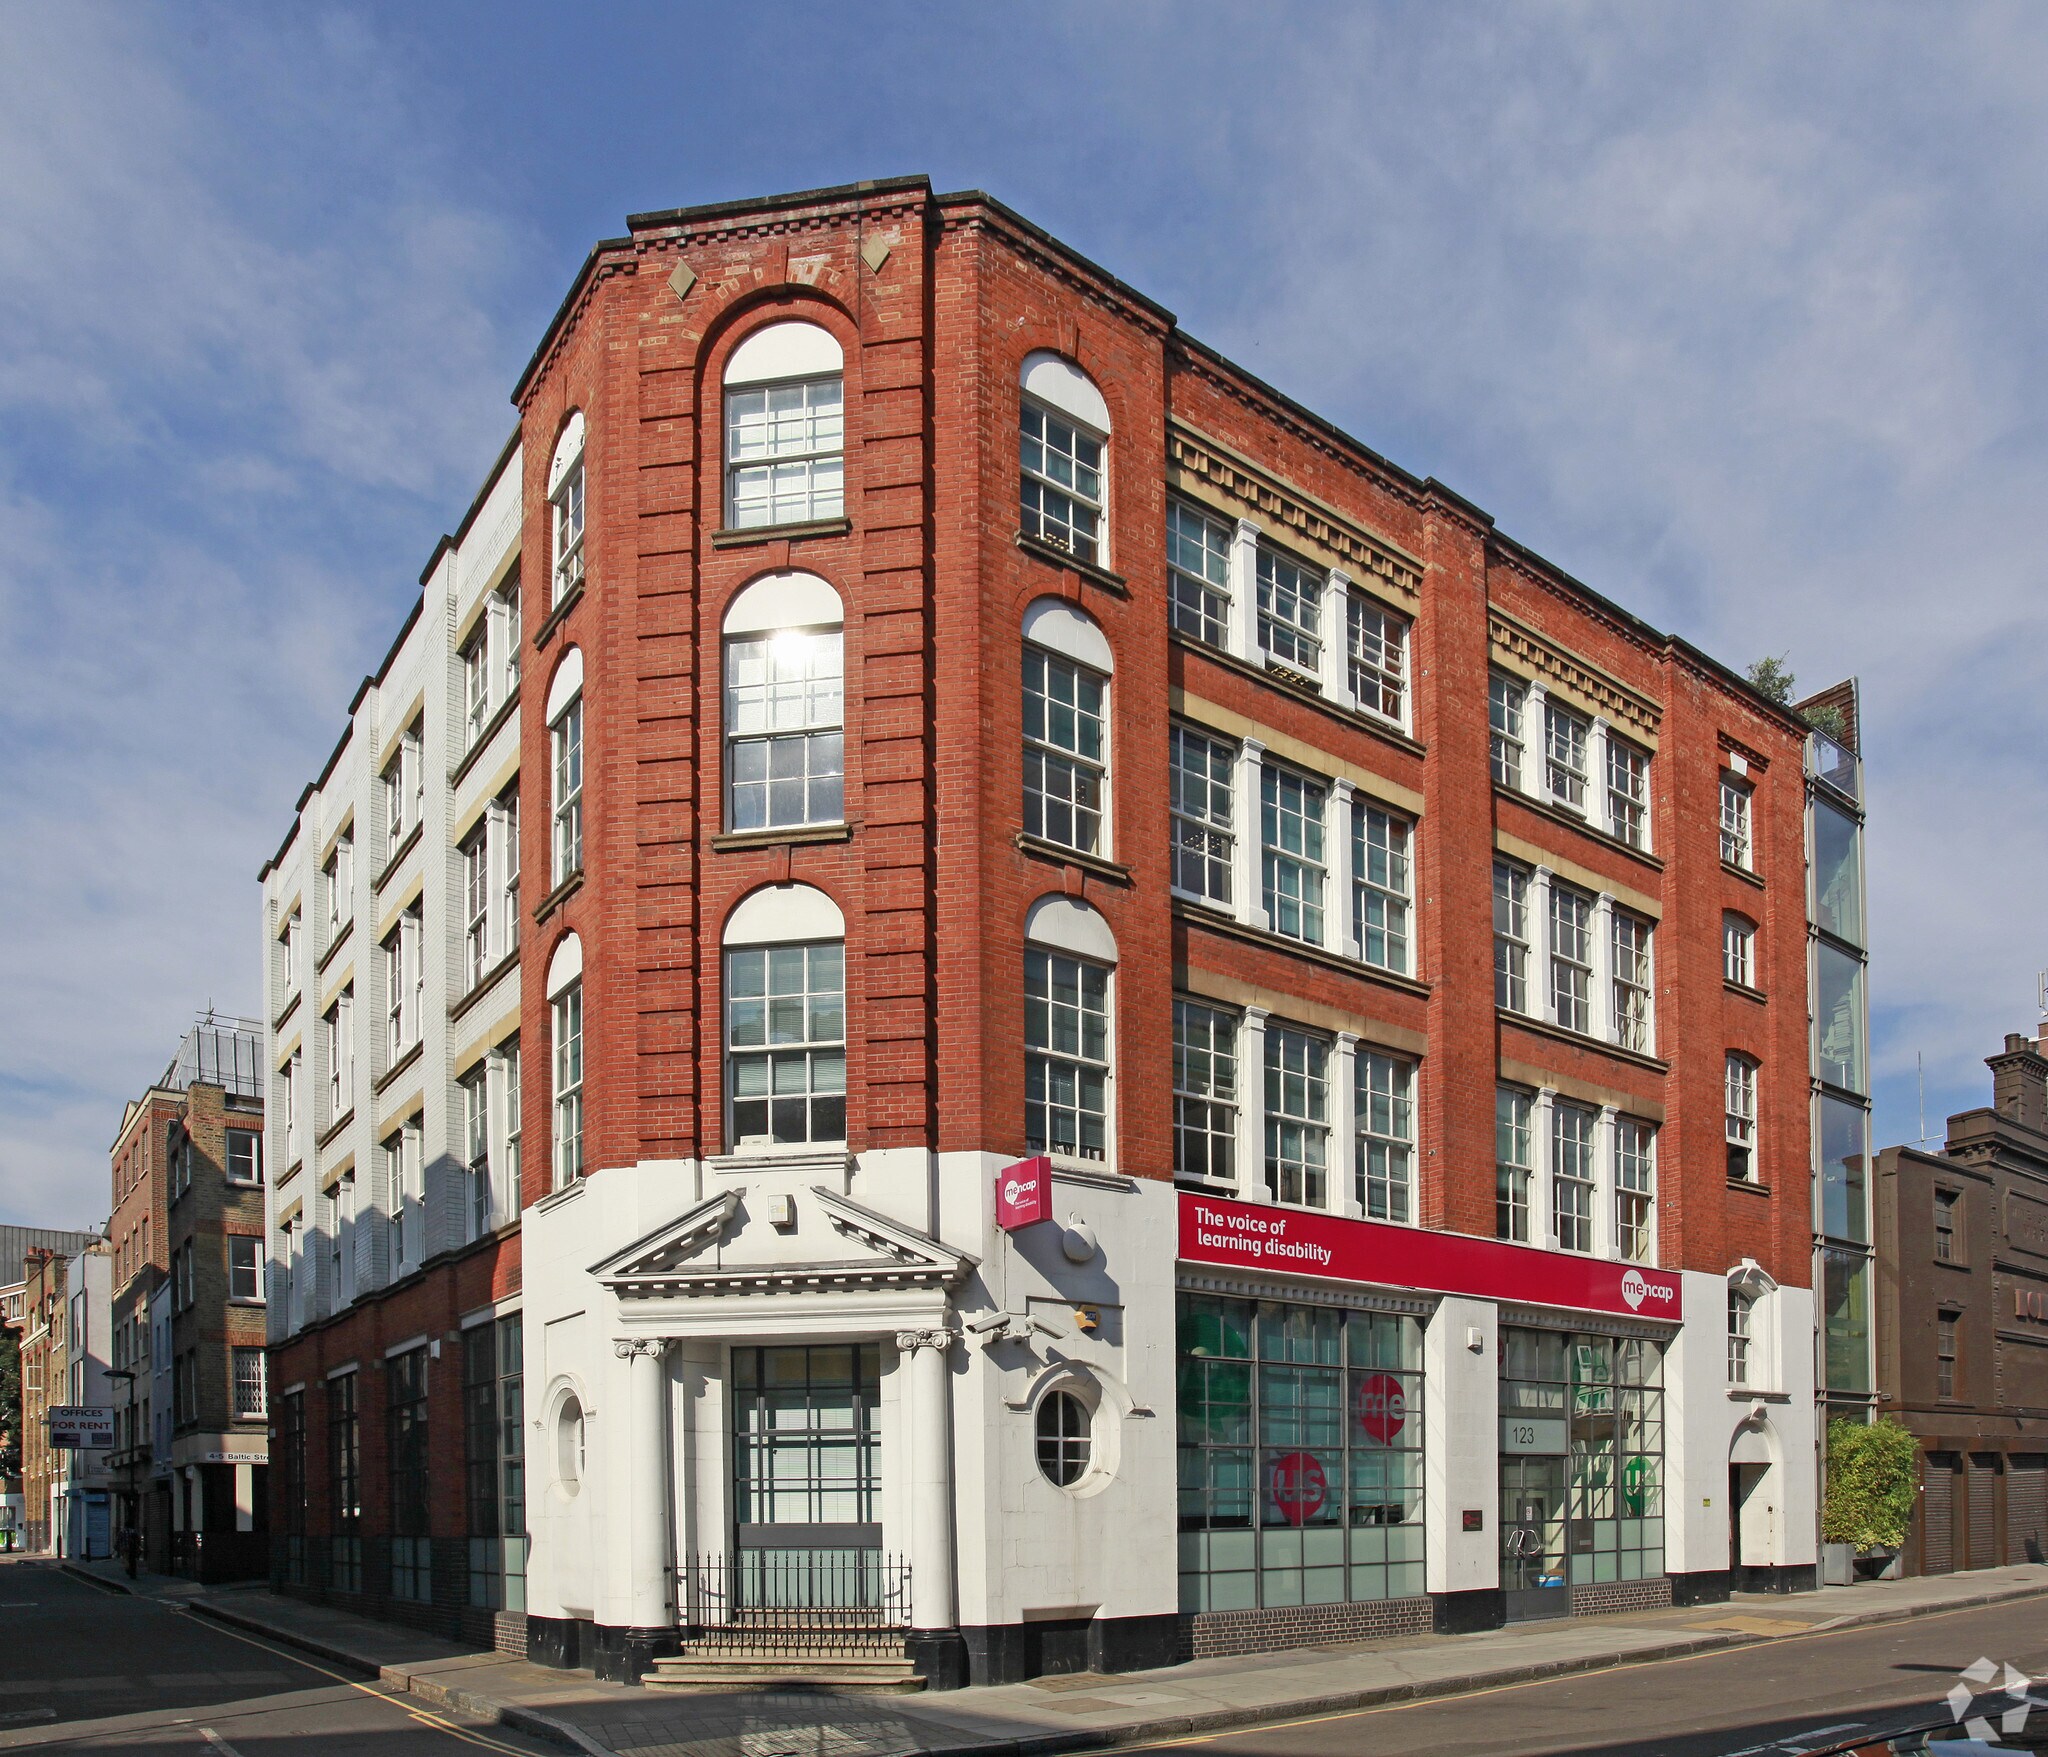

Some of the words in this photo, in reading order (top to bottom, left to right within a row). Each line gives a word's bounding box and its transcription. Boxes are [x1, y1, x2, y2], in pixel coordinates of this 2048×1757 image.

[1005, 1180, 1037, 1197] mencap
[1194, 1206, 1224, 1227] The
[1227, 1214, 1267, 1233] voice
[1270, 1220, 1287, 1236] of
[1197, 1228, 1262, 1257] learning
[1265, 1238, 1332, 1266] disability
[1623, 1281, 1674, 1304] mencap
[61, 1409, 103, 1417] OFFICES
[1361, 1392, 1406, 1420] me
[52, 1421, 76, 1429] FOR
[80, 1422, 112, 1430] RENT
[1512, 1426, 1535, 1444] 123
[1277, 1469, 1322, 1502] us
